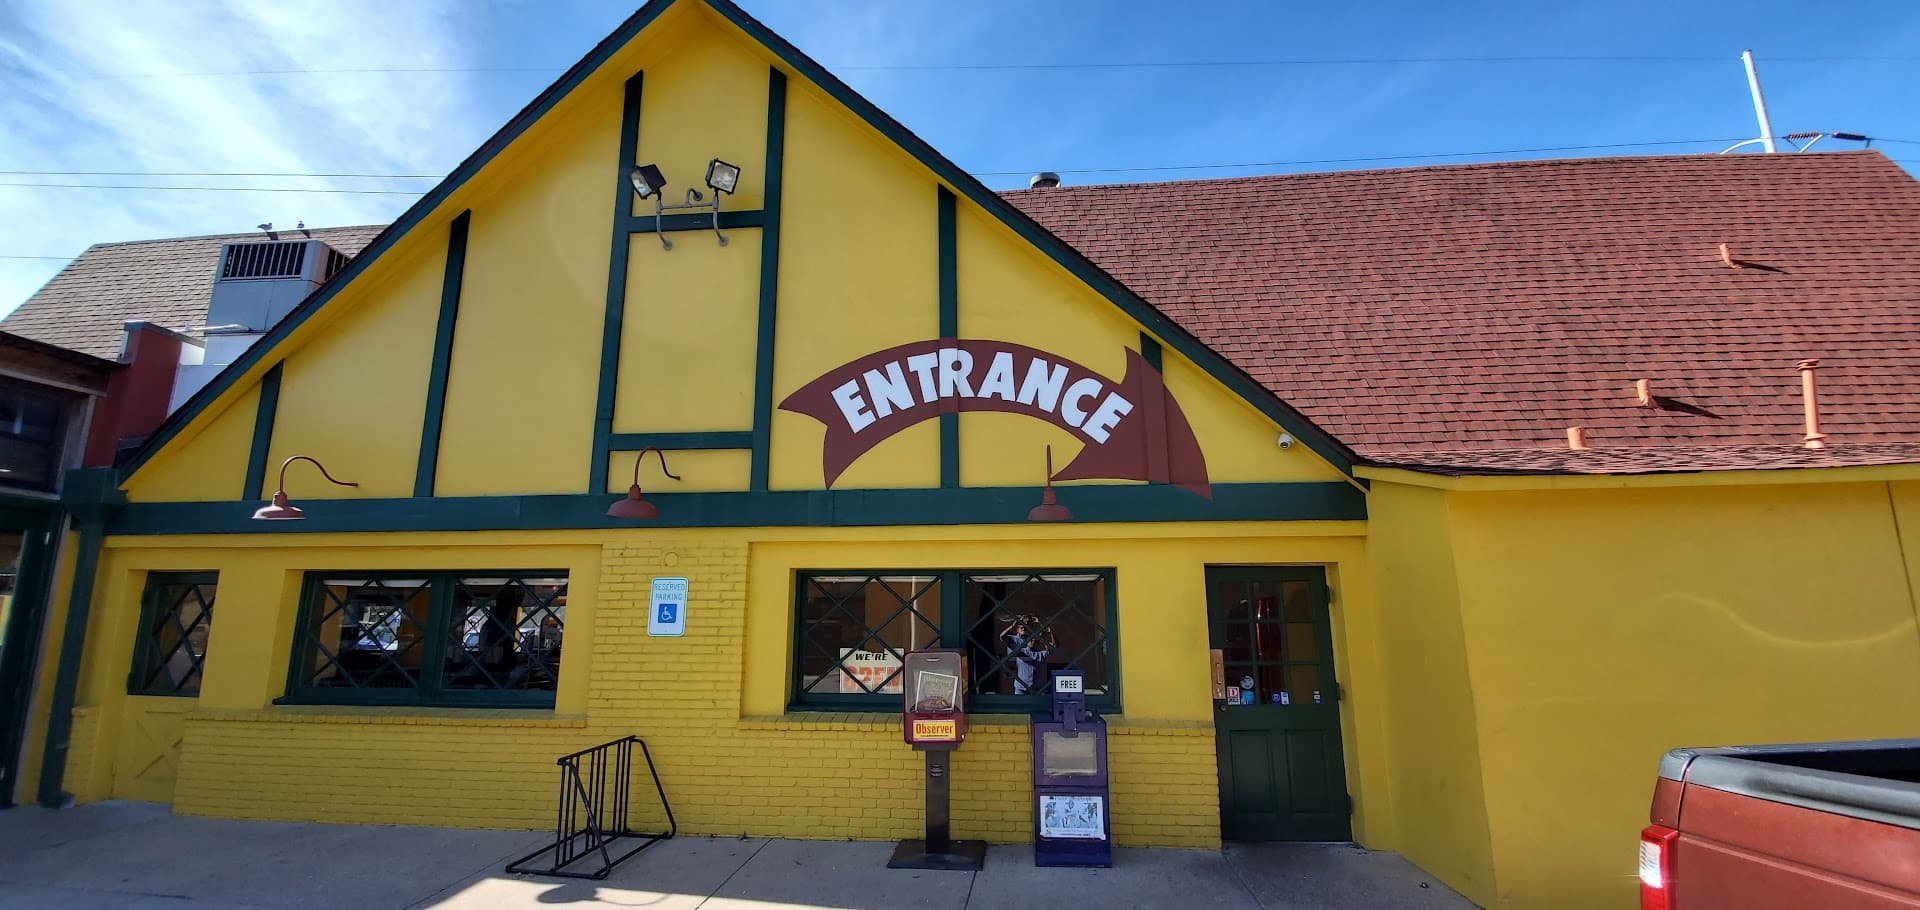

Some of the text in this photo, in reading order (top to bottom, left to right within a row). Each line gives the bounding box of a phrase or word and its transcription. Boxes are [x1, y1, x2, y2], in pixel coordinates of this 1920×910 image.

[831, 348, 1134, 445] ENTRANCE
[855, 653, 889, 661] WE'RE
[1060, 680, 1077, 689] FREE
[915, 723, 954, 734] Observer
